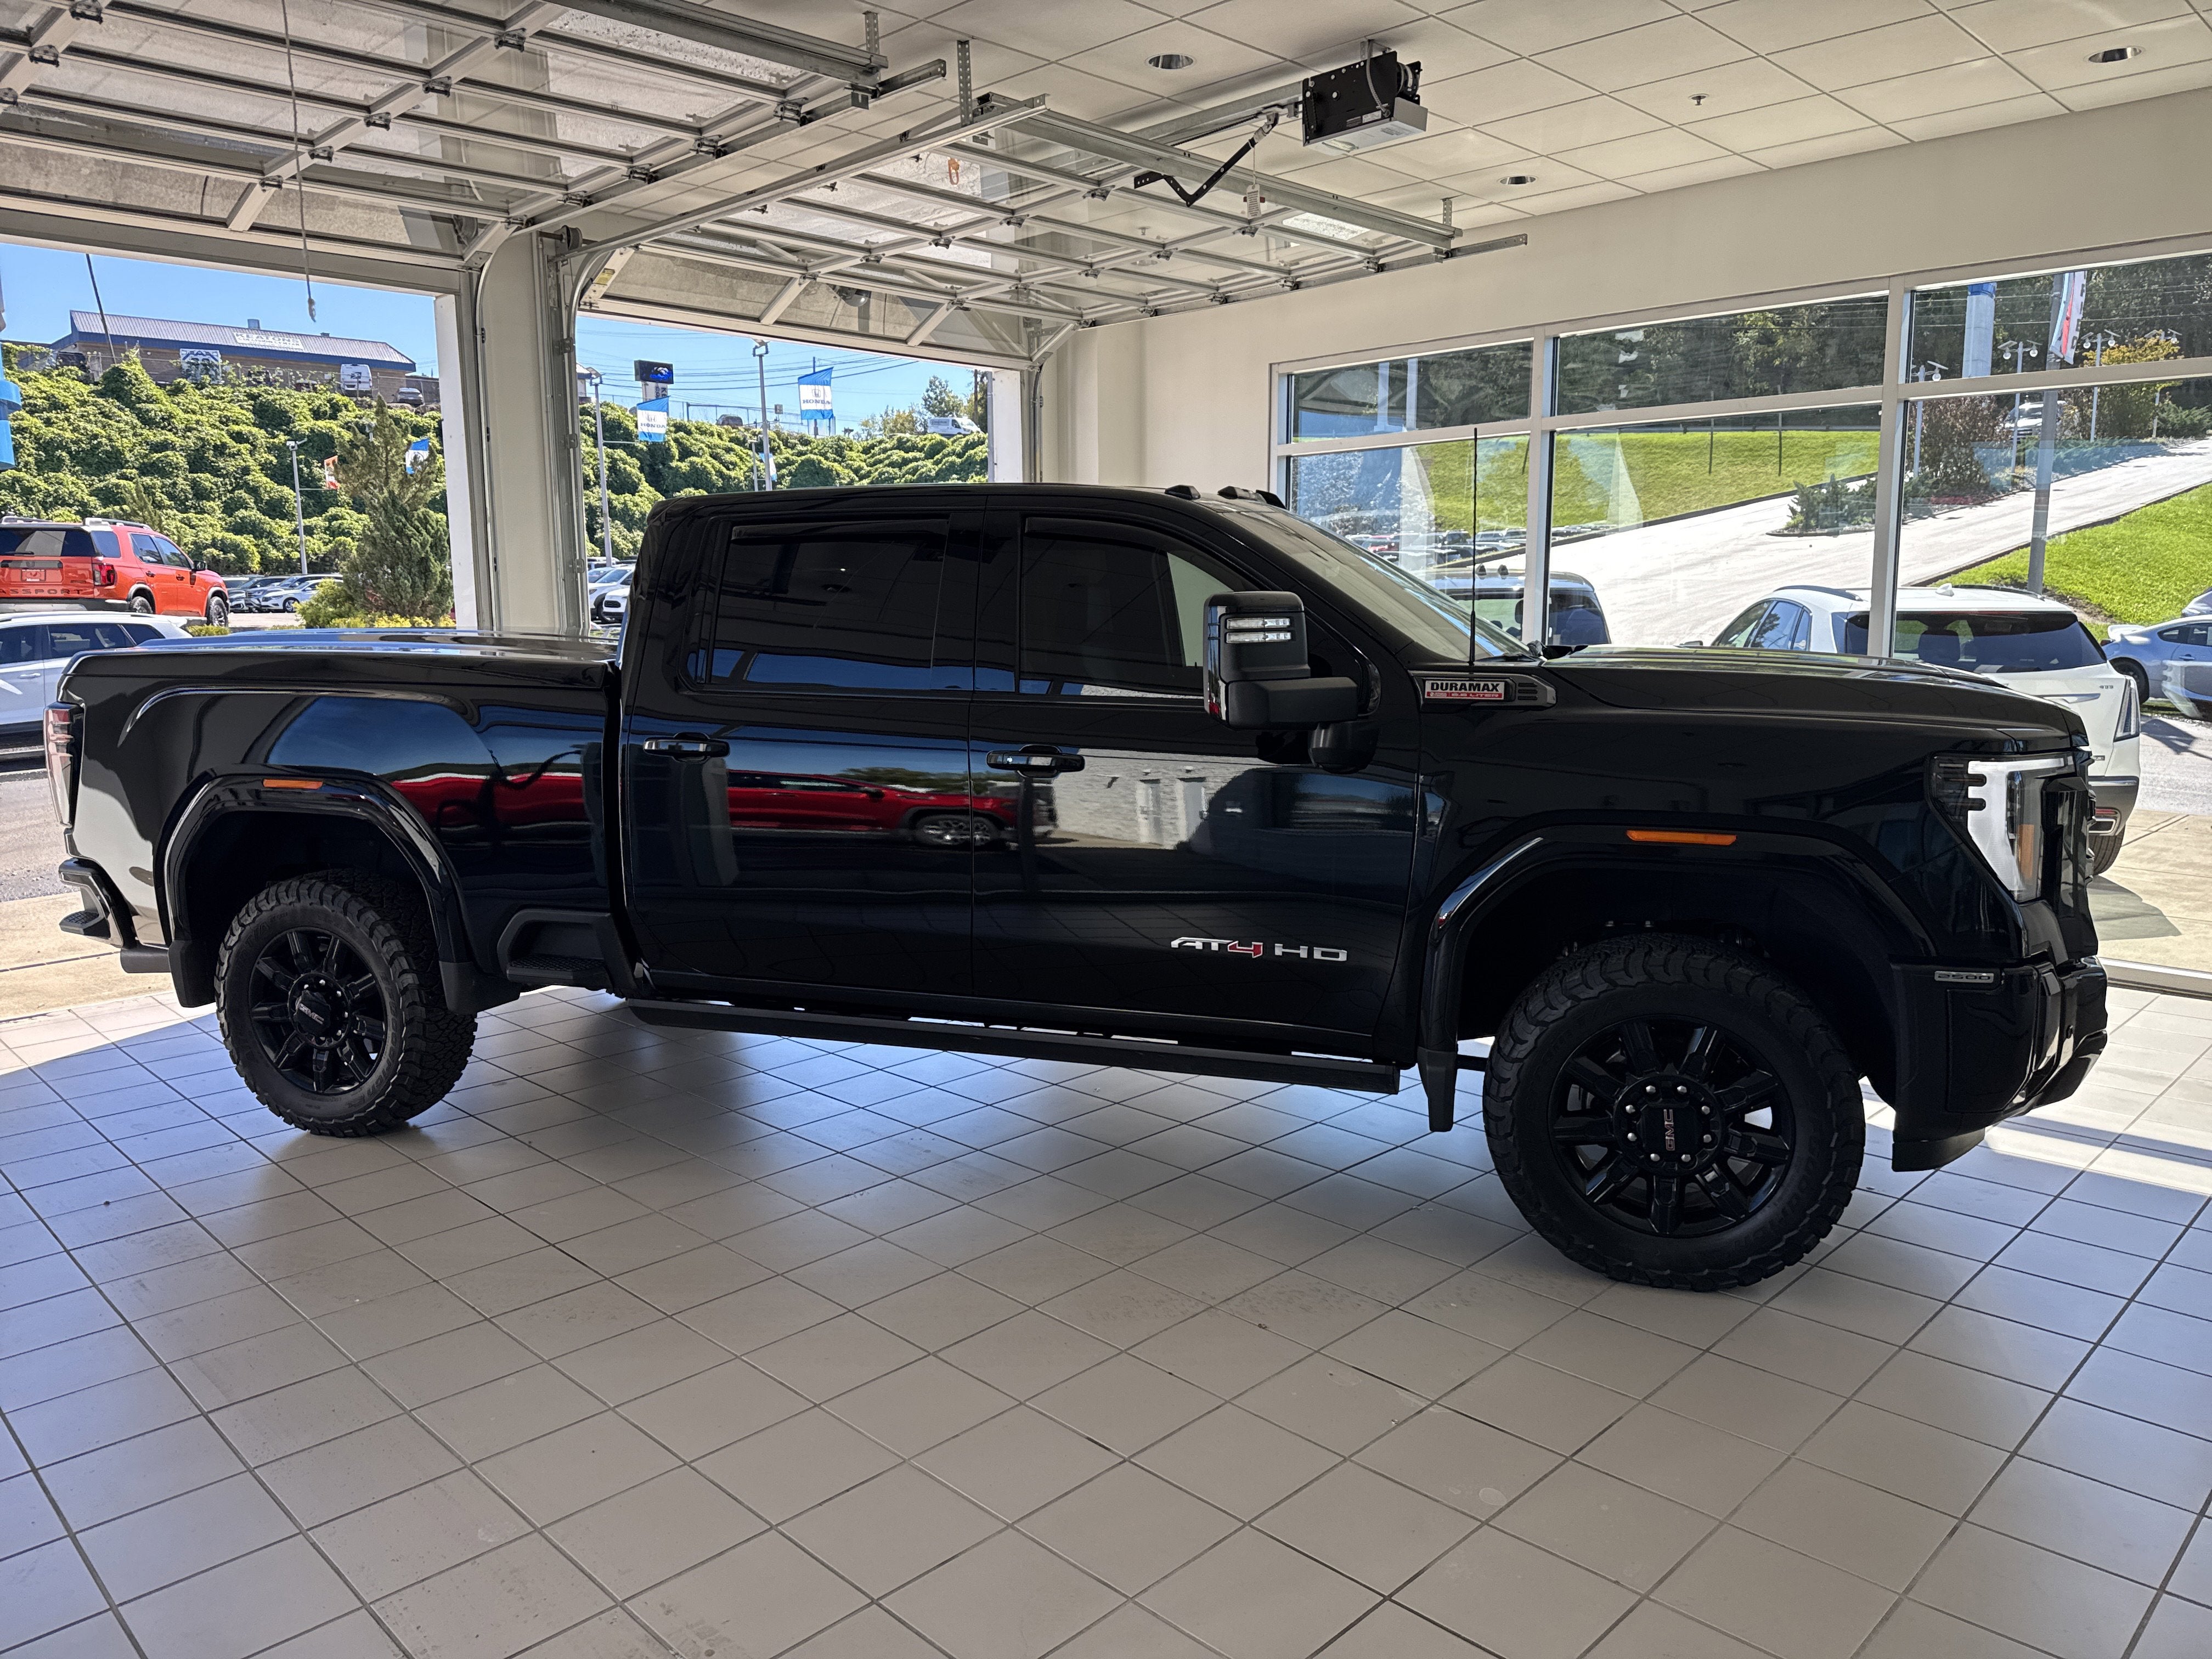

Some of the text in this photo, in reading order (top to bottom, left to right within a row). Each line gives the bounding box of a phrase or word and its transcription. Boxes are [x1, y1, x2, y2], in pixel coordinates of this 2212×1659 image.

[1430, 682, 1500, 692] DURAMAX
[1171, 936, 1347, 961] AT4 HD
[298, 1002, 325, 1025] GMC
[1663, 1109, 1675, 1150] GMC
